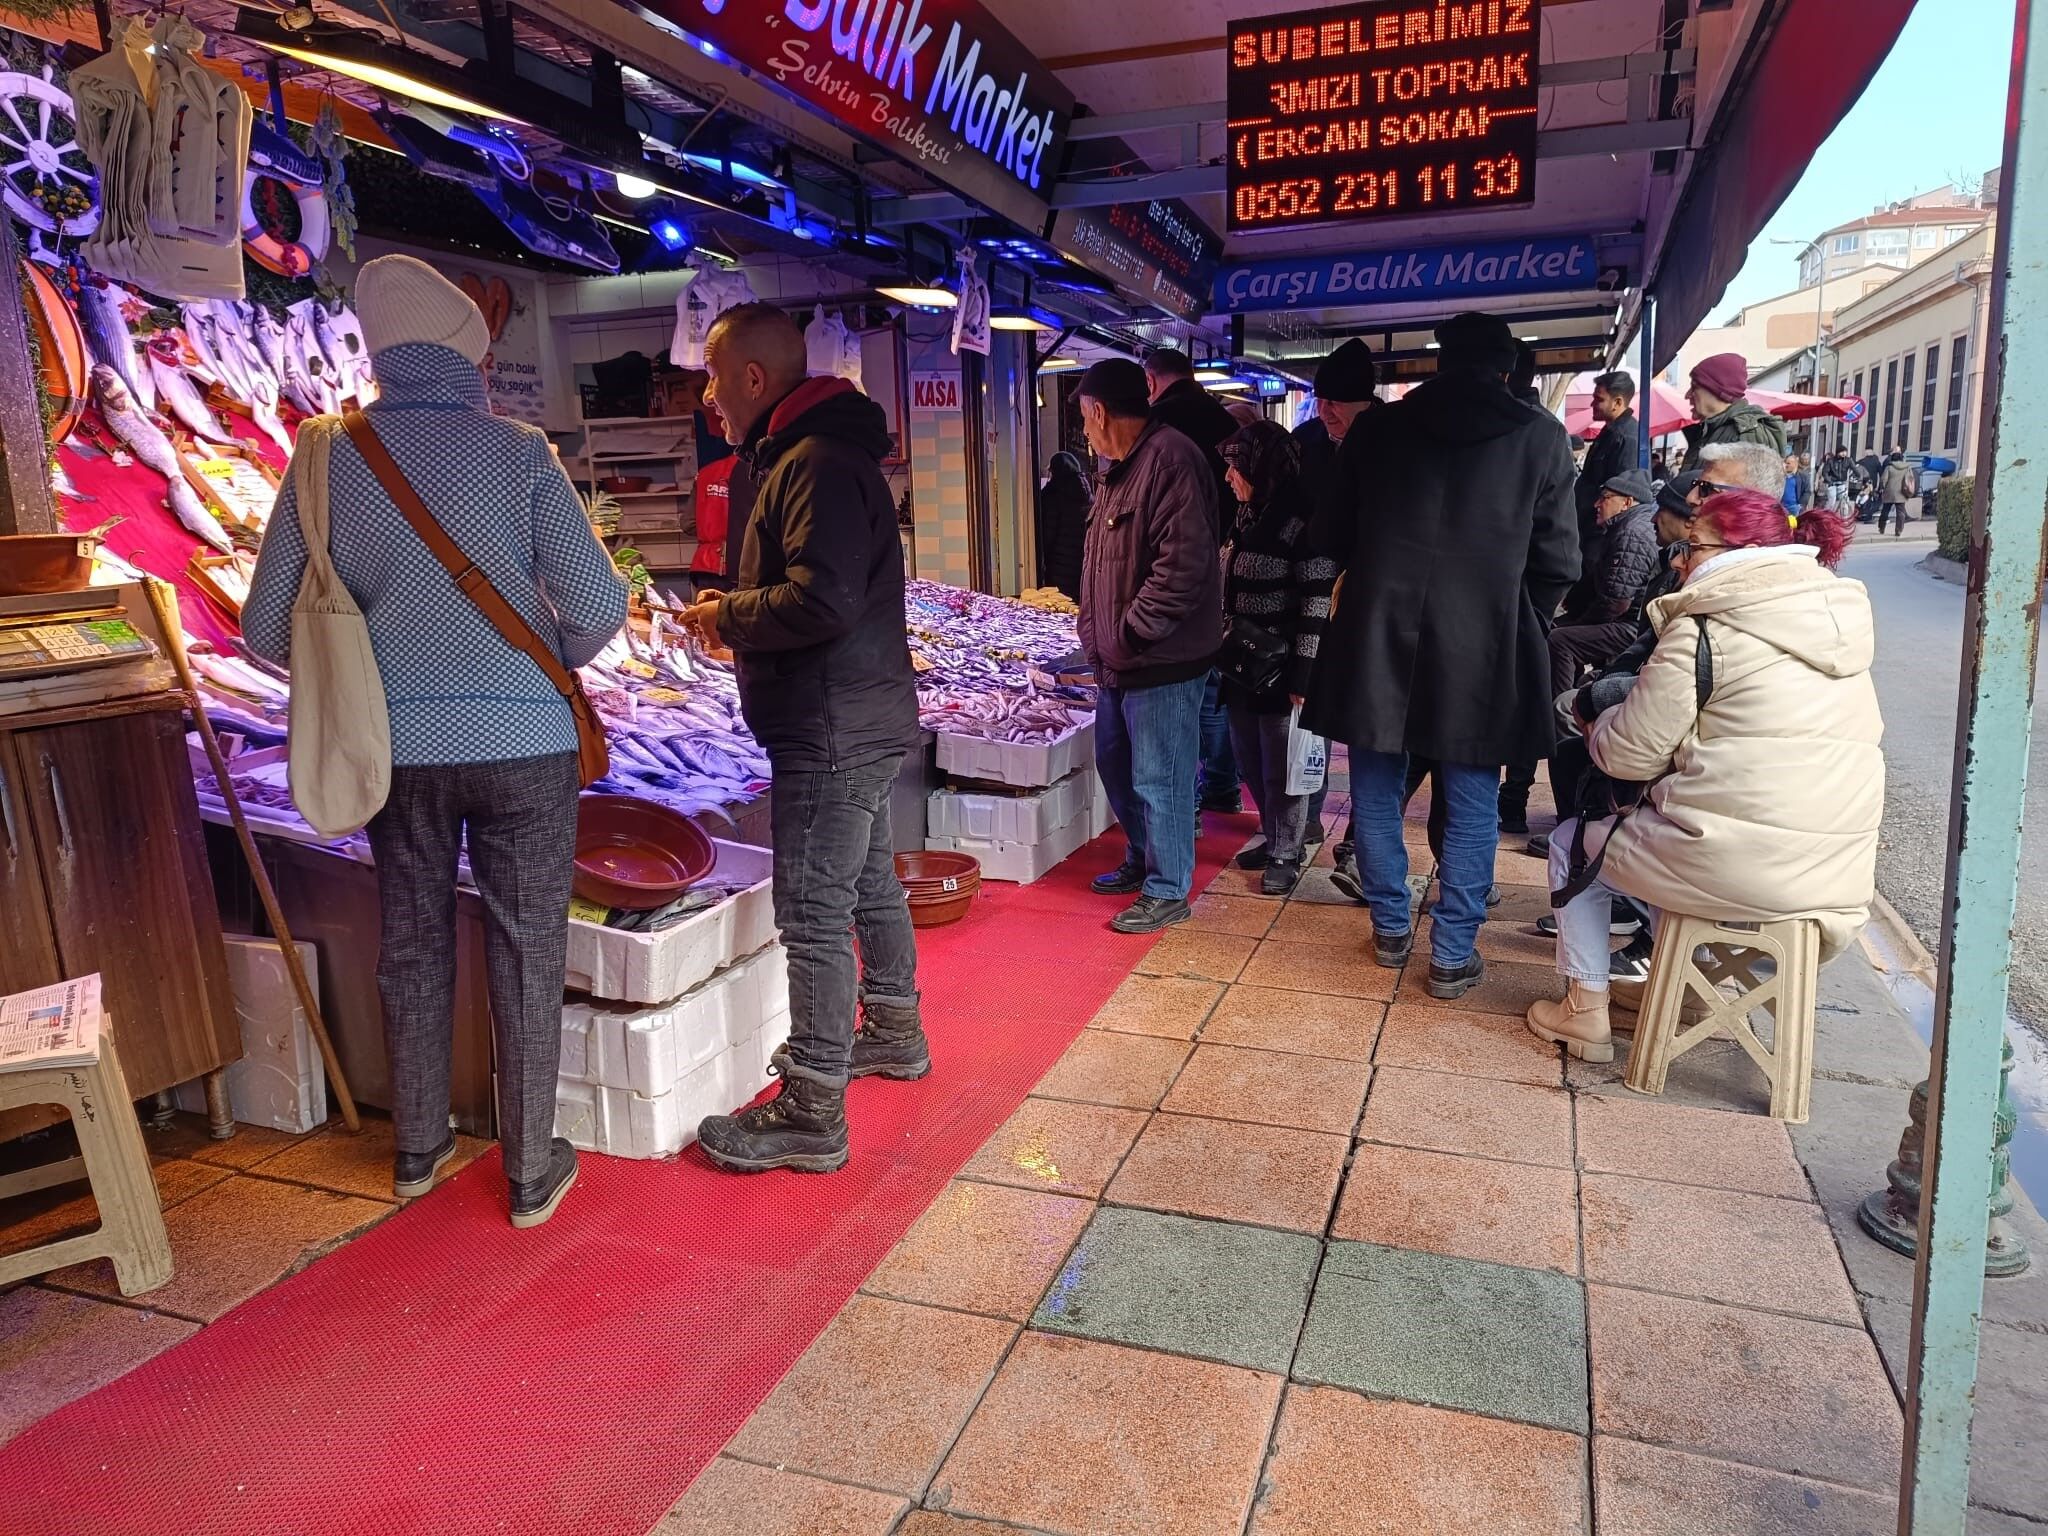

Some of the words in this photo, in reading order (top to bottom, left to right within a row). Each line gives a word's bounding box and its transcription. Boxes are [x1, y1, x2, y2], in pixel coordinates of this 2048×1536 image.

[1371, 52, 1529, 104] TOPRAK
[924, 21, 1054, 189] Market
[1235, 177, 1322, 221] 0552
[1333, 169, 1398, 211] 231
[1417, 161, 1457, 203] 11
[1473, 153, 1522, 197] 33
[1225, 268, 1319, 308] Çarşı
[1326, 253, 1428, 293] Balık
[1434, 243, 1586, 287] Market
[486, 352, 494, 370] 2
[497, 360, 514, 374] gün
[516, 362, 537, 376] balık
[507, 379, 534, 395] sağlık
[914, 380, 957, 407] KASA
[82, 542, 89, 556] 5
[945, 880, 955, 890] 25
